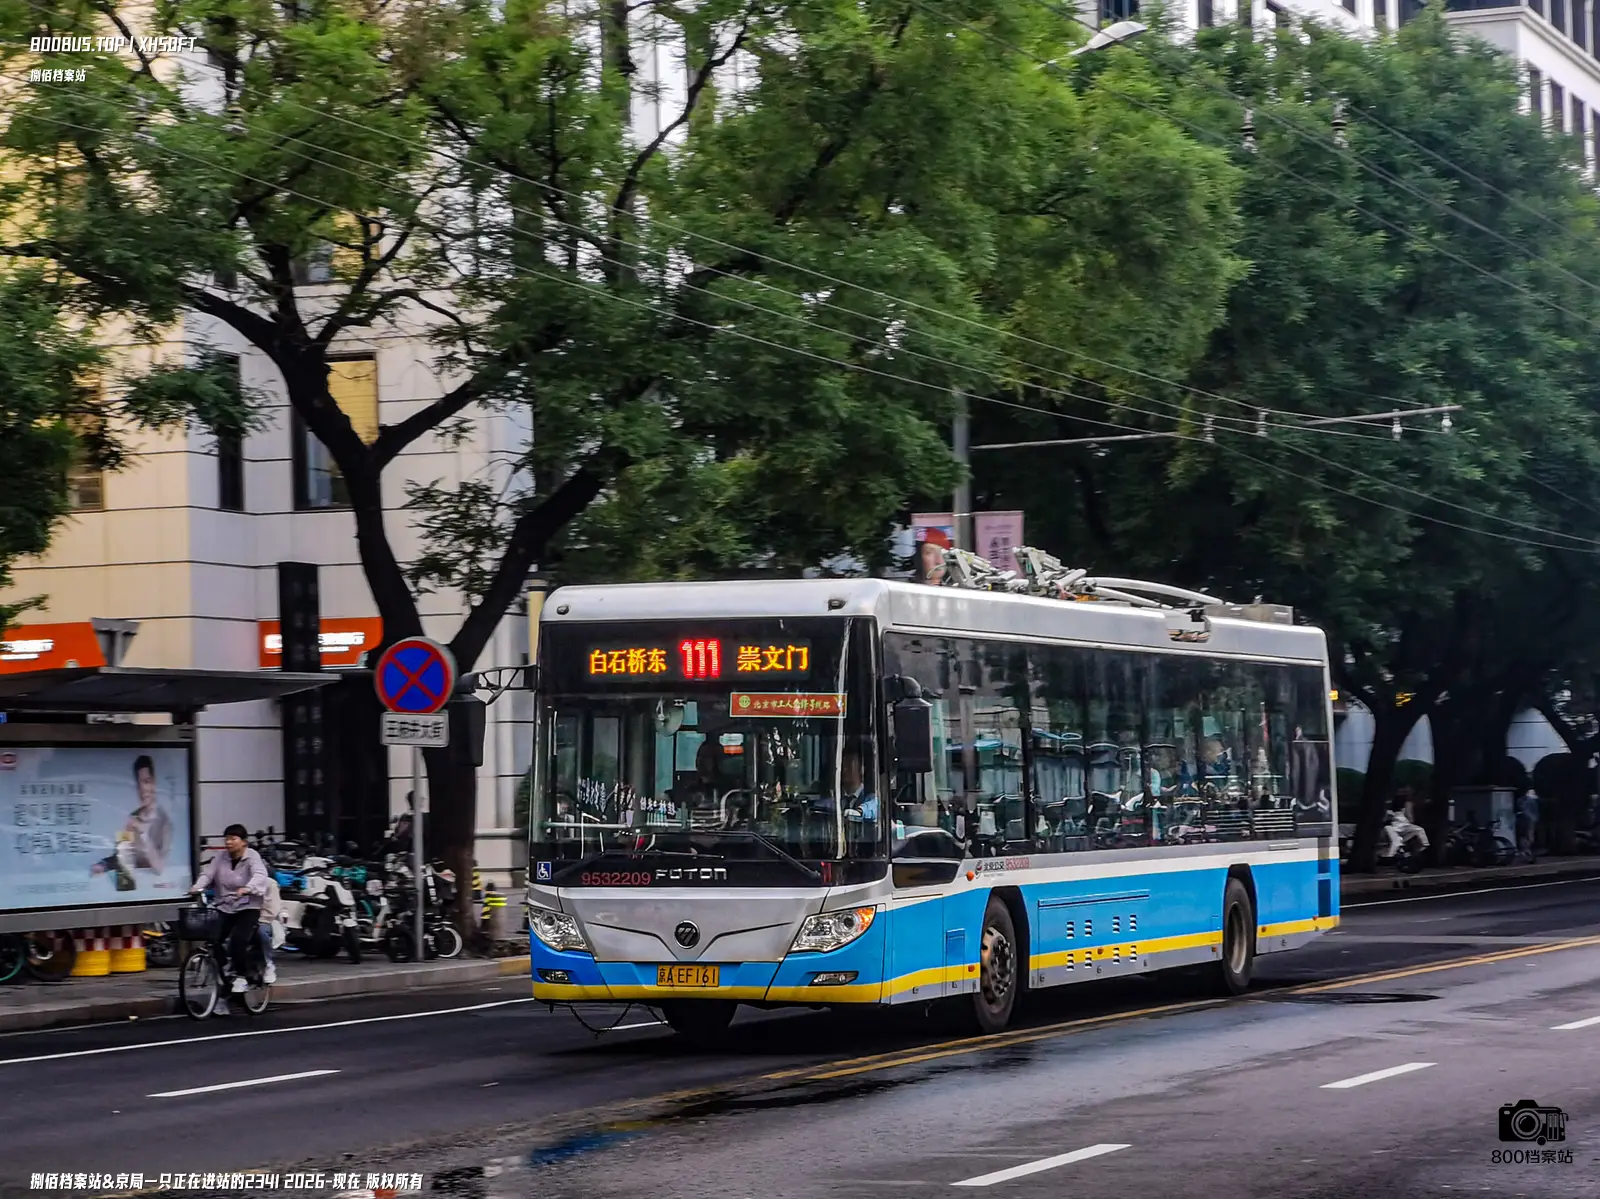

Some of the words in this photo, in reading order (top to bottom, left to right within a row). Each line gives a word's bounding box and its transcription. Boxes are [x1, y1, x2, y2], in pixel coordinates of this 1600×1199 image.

[589, 648, 667, 675] 白石桥东
[681, 639, 721, 678] 111
[737, 645, 809, 671] 崇文门
[581, 872, 651, 886] 9532209
[655, 868, 728, 881] FOTON
